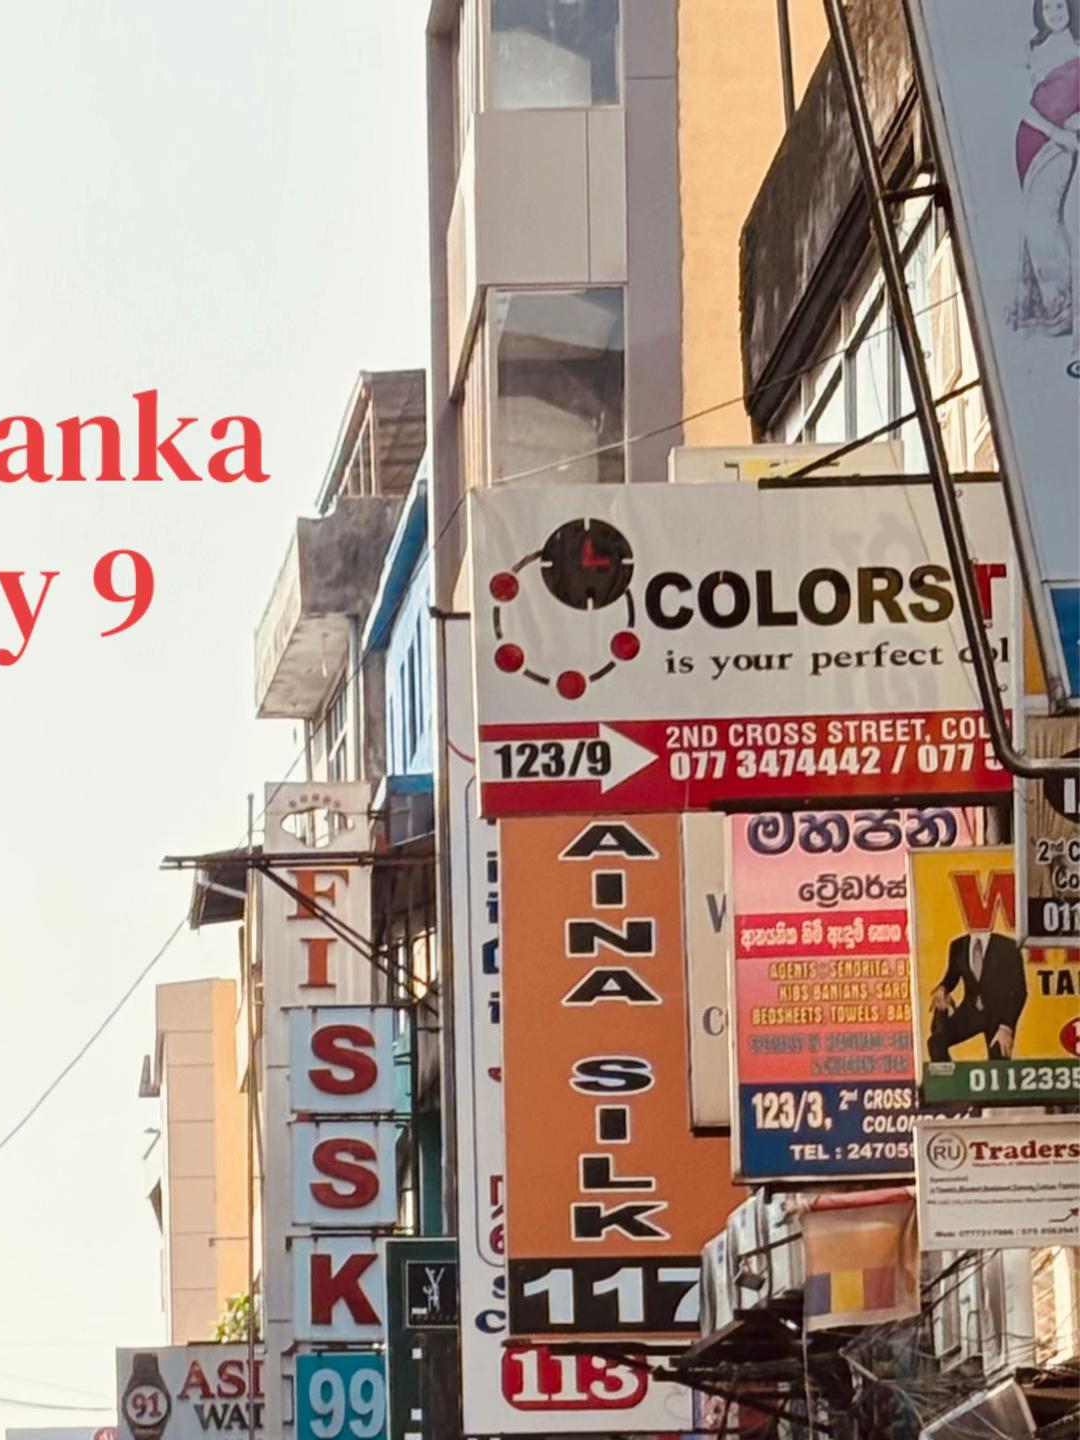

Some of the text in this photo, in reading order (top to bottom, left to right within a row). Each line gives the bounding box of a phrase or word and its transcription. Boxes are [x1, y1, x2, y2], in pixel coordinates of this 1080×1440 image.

[666, 650, 695, 674] is
[710, 652, 792, 680] your
[810, 641, 943, 676] perfect
[665, 725, 718, 749] 2ND
[728, 722, 817, 747] CROSS
[827, 718, 933, 744] STREET,
[493, 741, 612, 779] 123/9
[670, 750, 726, 781] 077
[736, 746, 881, 778] 3474442
[918, 742, 975, 773] 077
[558, 820, 663, 1006] AINA
[778, 983, 809, 1001] KIDS
[863, 1087, 912, 1110] CROSS
[569, 1056, 671, 1241] SILK
[789, 1144, 830, 1161] TEL
[969, 1139, 1080, 1161] Traders
[522, 1268, 701, 1326] 117
[512, 1349, 640, 1402] 113
[132, 1391, 163, 1419] 91
[308, 1367, 387, 1440] 99
